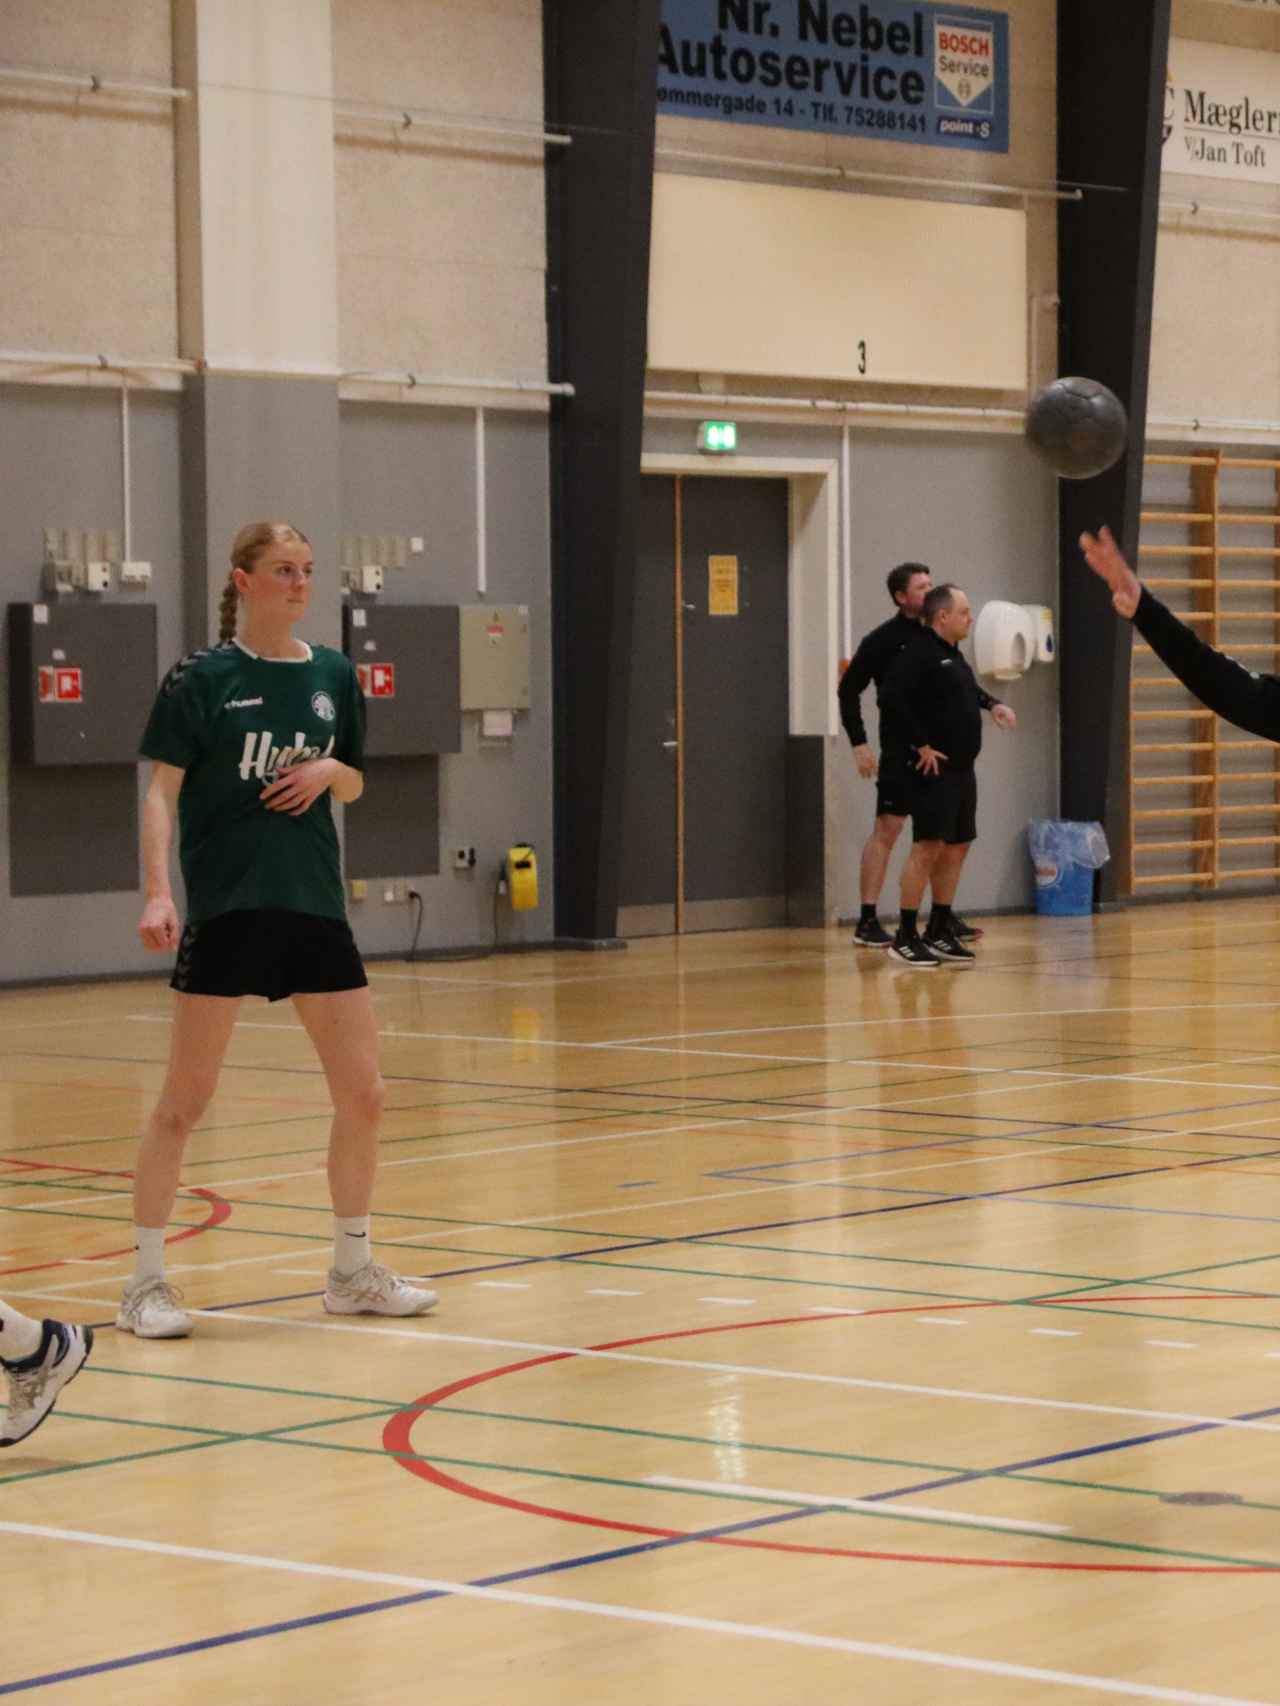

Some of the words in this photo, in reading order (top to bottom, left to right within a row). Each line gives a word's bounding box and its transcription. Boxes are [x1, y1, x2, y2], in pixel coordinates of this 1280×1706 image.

[717, 0, 780, 38] Nr.
[799, 0, 926, 58] Nebel
[938, 31, 990, 57] BOSCH
[656, 22, 926, 106] Autoservice
[938, 54, 990, 78] Service
[773, 98, 795, 117] 14
[810, 101, 839, 124] Tlf.
[844, 105, 927, 133] 75288141
[1231, 141, 1266, 167] Toft
[857, 339, 867, 375] 3
